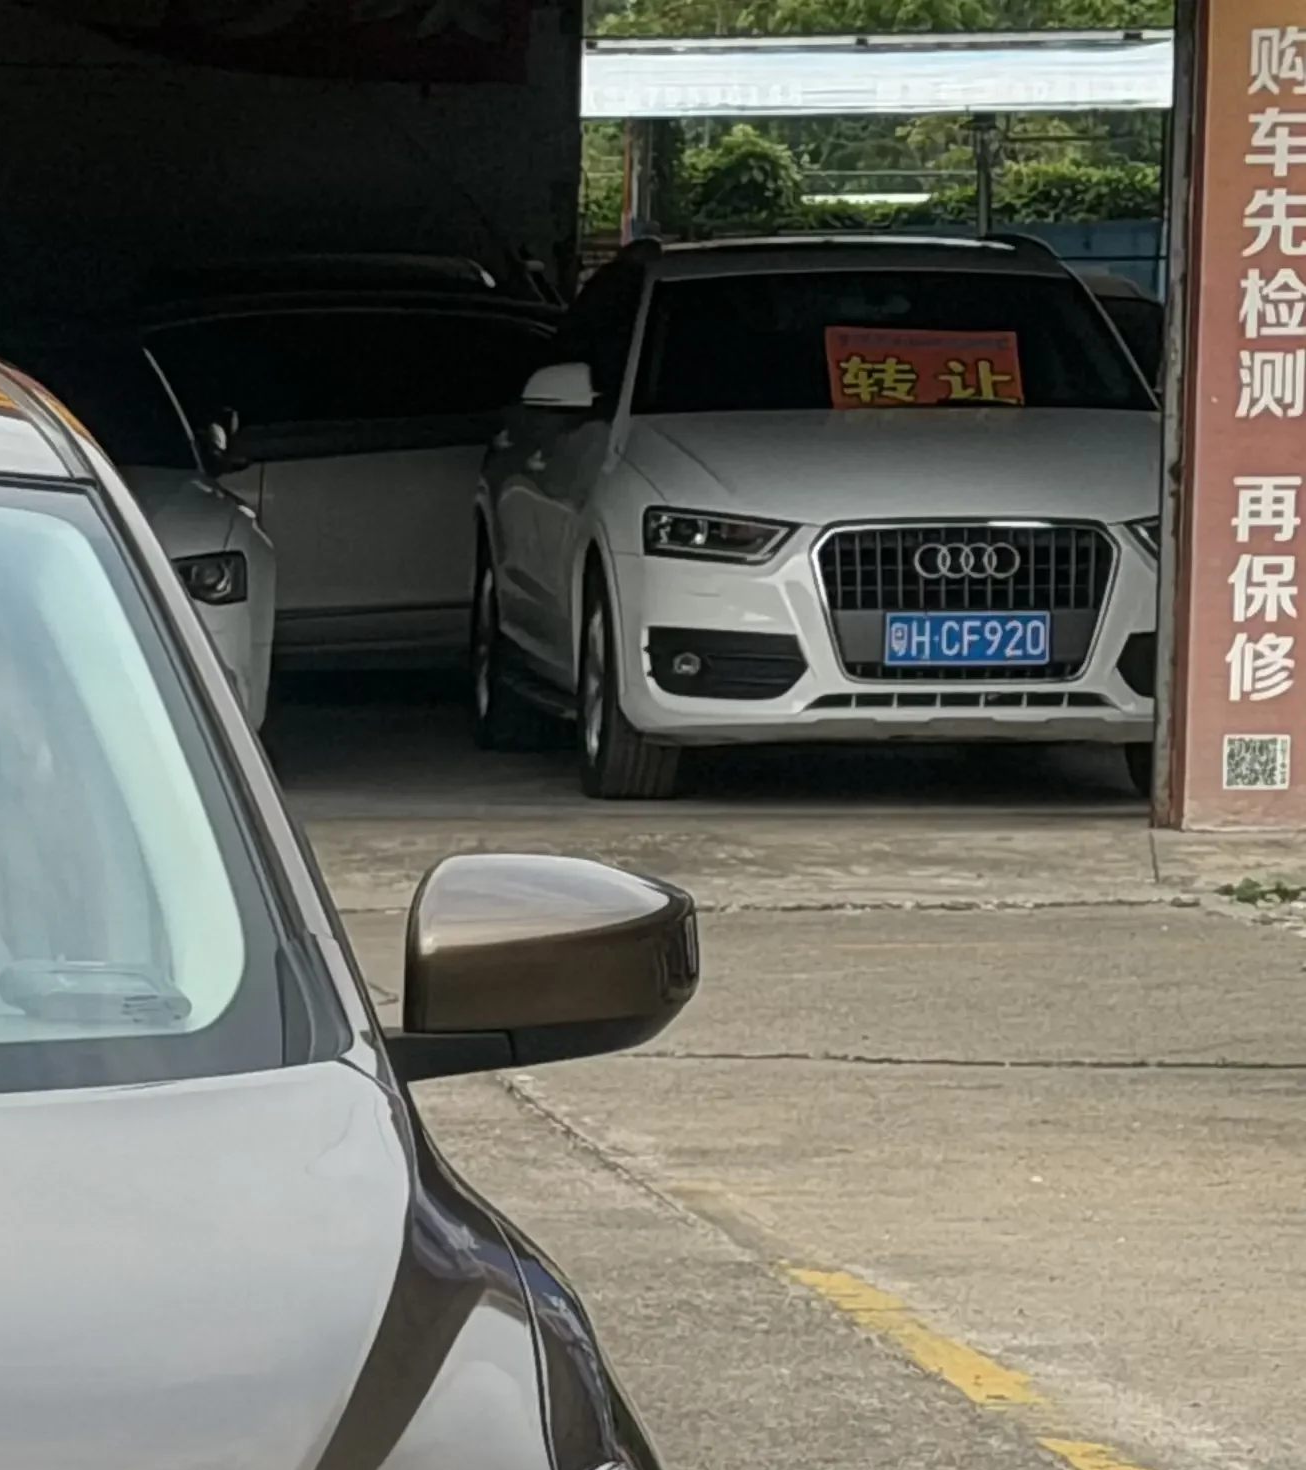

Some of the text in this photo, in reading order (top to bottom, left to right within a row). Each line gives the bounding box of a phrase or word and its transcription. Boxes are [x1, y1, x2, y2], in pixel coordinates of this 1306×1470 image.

[839, 355, 1018, 404] 转让
[1225, 26, 1306, 702] 购车先检测 再保修
